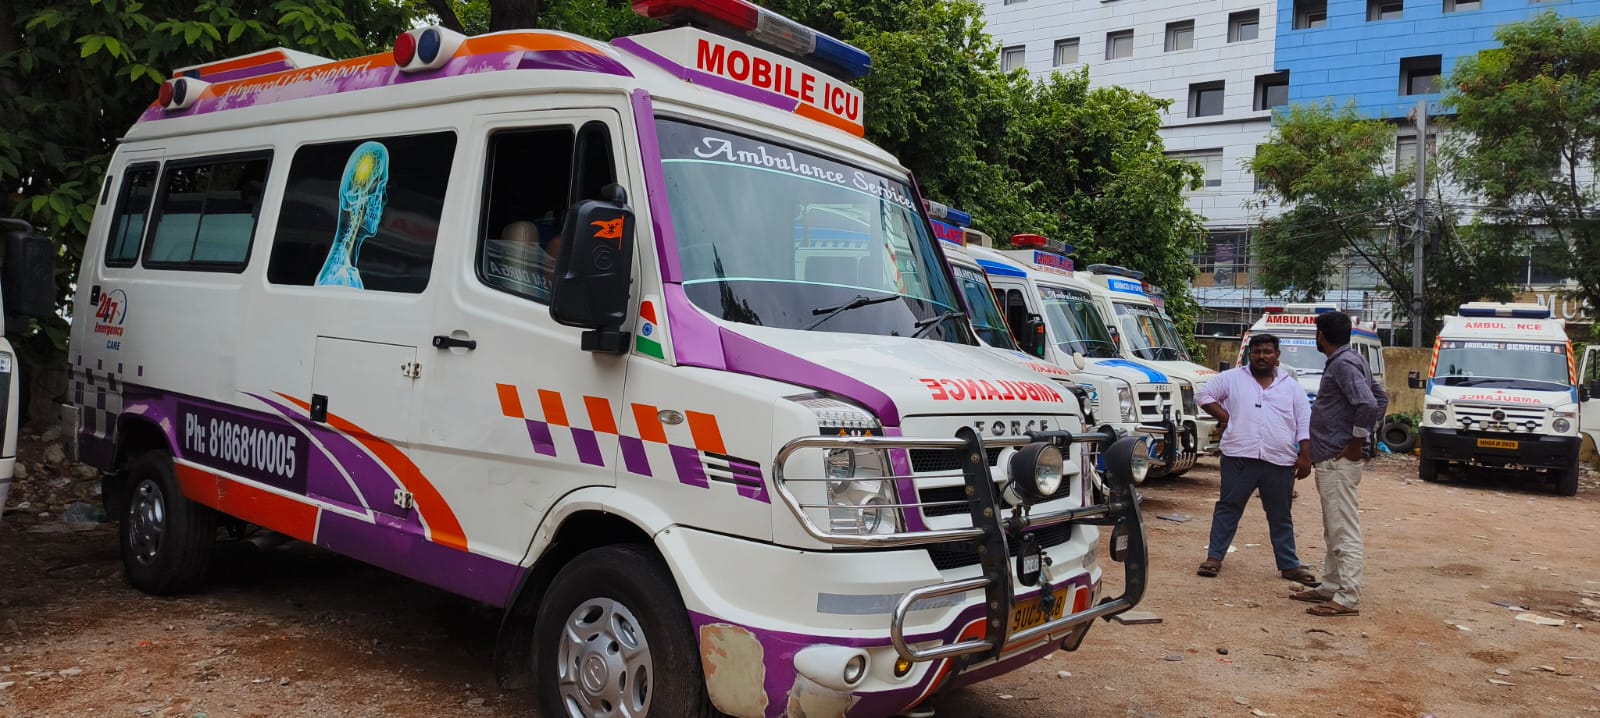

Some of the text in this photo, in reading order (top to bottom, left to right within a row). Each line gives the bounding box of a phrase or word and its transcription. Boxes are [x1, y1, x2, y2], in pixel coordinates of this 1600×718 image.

[223, 75, 285, 98] Advanced
[309, 60, 373, 86] Support
[696, 38, 859, 121] MOBILE ICU
[694, 136, 846, 185] Ambulance
[1266, 315, 1317, 325] AMBULAN
[95, 321, 124, 337] Emergency
[106, 340, 121, 351] CARE
[1506, 343, 1552, 353] SERVICES
[974, 419, 1049, 436] FORCE
[185, 412, 297, 479] Ph: 8186810005
